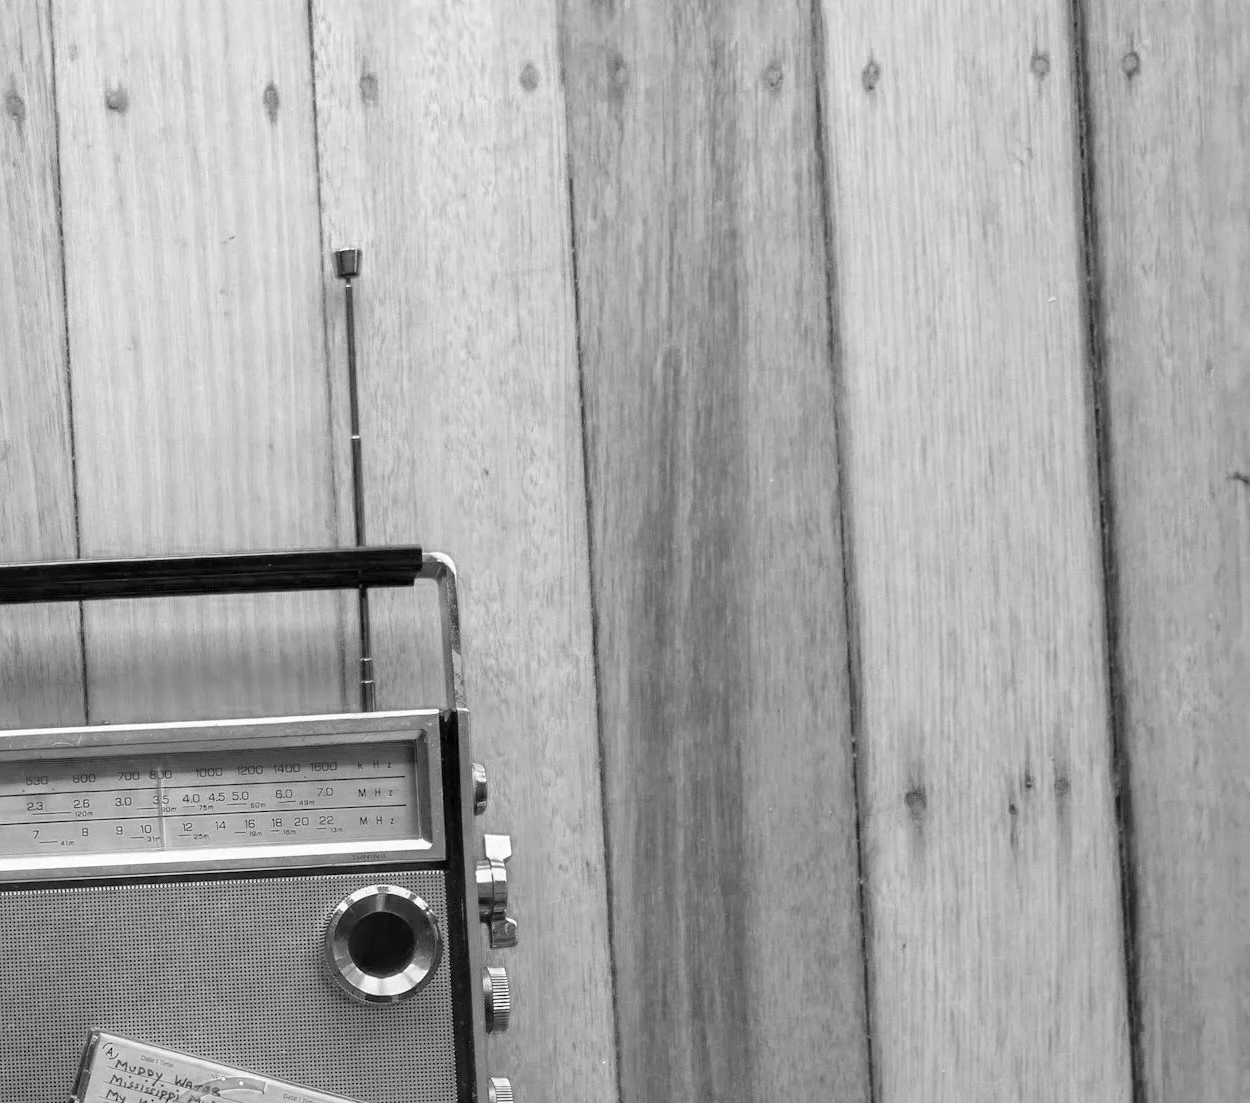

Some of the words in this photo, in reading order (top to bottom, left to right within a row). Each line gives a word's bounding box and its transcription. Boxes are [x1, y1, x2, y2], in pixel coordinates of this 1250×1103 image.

[25, 775, 49, 786] 530
[73, 773, 96, 784] 600
[118, 770, 140, 781] 700
[150, 769, 173, 780] 800
[195, 767, 223, 778] 1000
[237, 765, 264, 776] 1200
[273, 763, 301, 773] 1400
[311, 761, 338, 772] 1600
[26, 801, 44, 812] 2.3
[73, 799, 90, 809] 2.6
[115, 796, 132, 807] 3.0
[182, 793, 200, 804] 4.0
[208, 792, 226, 803] 4.5
[231, 791, 249, 802] 5.0
[275, 789, 293, 799] 6.0
[317, 787, 334, 797] 7.0
[32, 830, 40, 840] 7
[81, 828, 89, 837] 8
[115, 825, 123, 835] 9
[140, 824, 152, 834] 10
[182, 822, 193, 832] 12
[215, 821, 227, 830] 14
[244, 819, 256, 829] 16
[271, 818, 283, 828] 18
[294, 816, 310, 827] 20
[318, 815, 335, 826] 22
[114, 1059, 163, 1087] MUDDY
[174, 1074, 222, 1098] WATER
